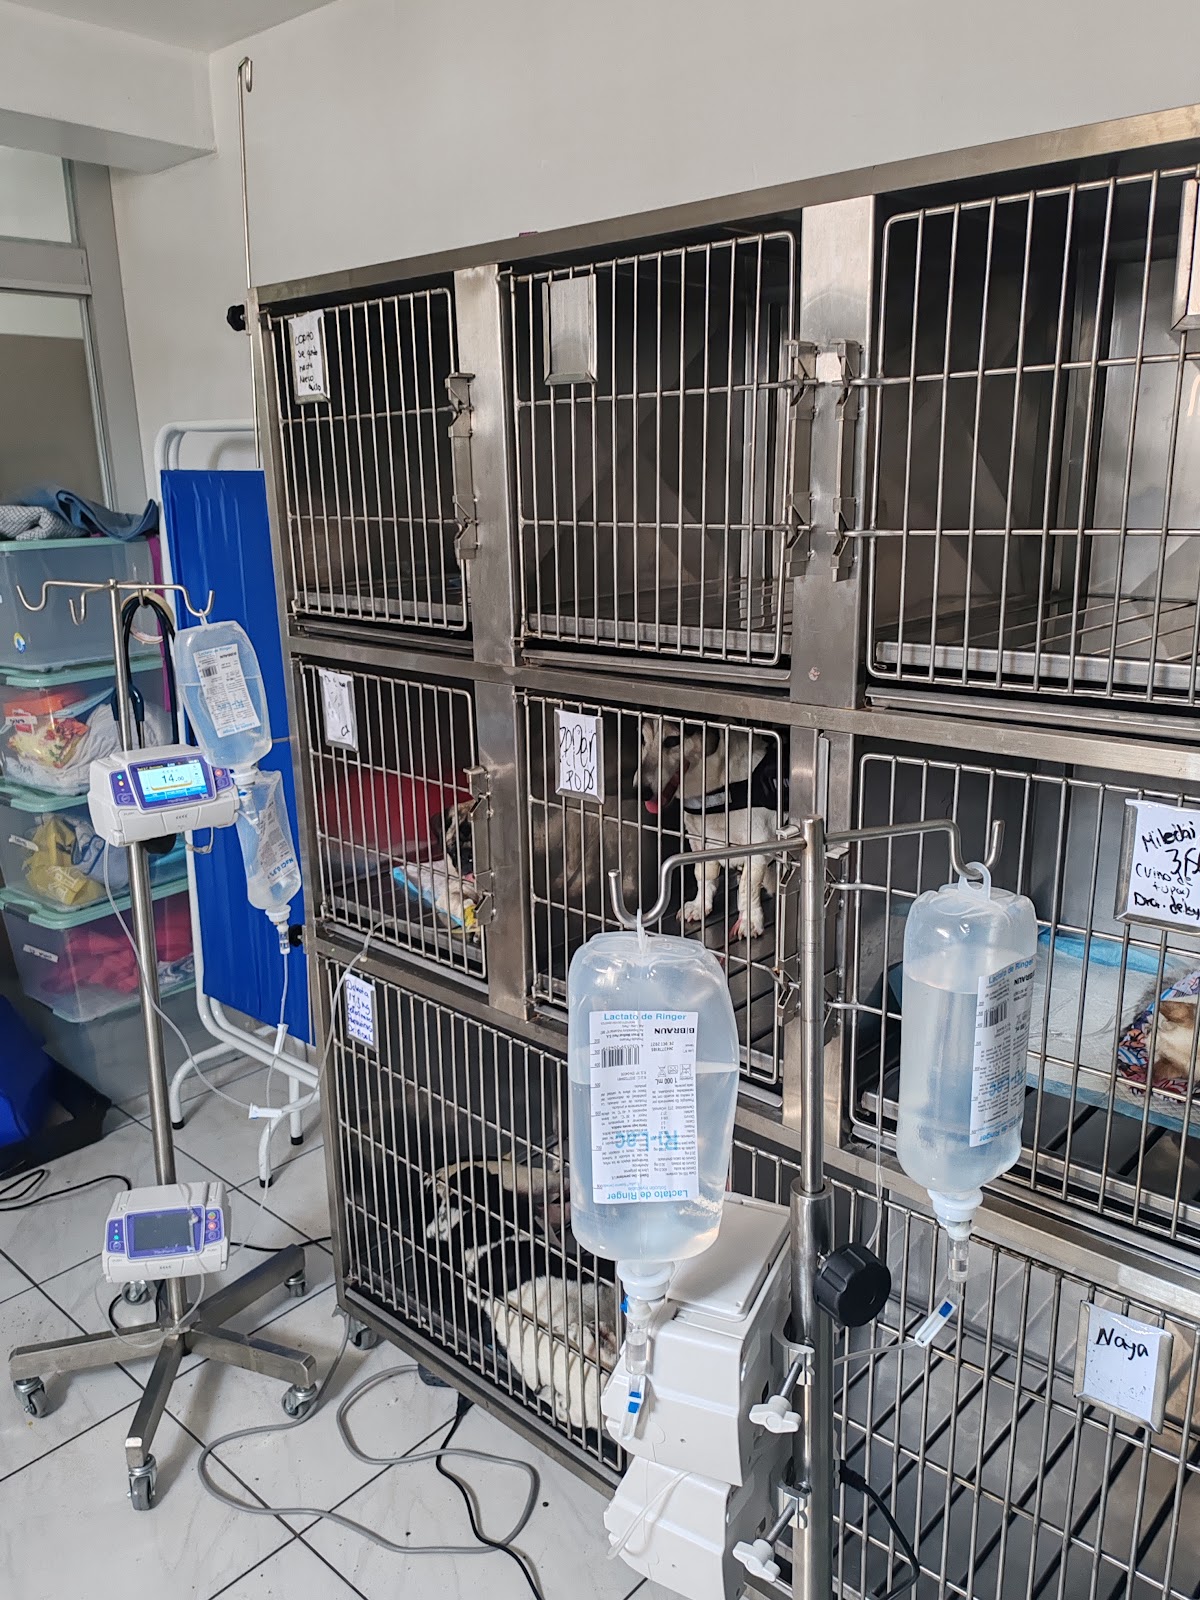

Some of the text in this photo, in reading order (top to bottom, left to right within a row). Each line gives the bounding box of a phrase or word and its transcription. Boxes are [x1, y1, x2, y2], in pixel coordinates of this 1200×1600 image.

[603, 1013, 639, 1021] Lactato
[655, 1013, 687, 1022] Ringer
[607, 1189, 689, 1200] Lactato de Ringer
[1096, 1327, 1149, 1361] Naya
